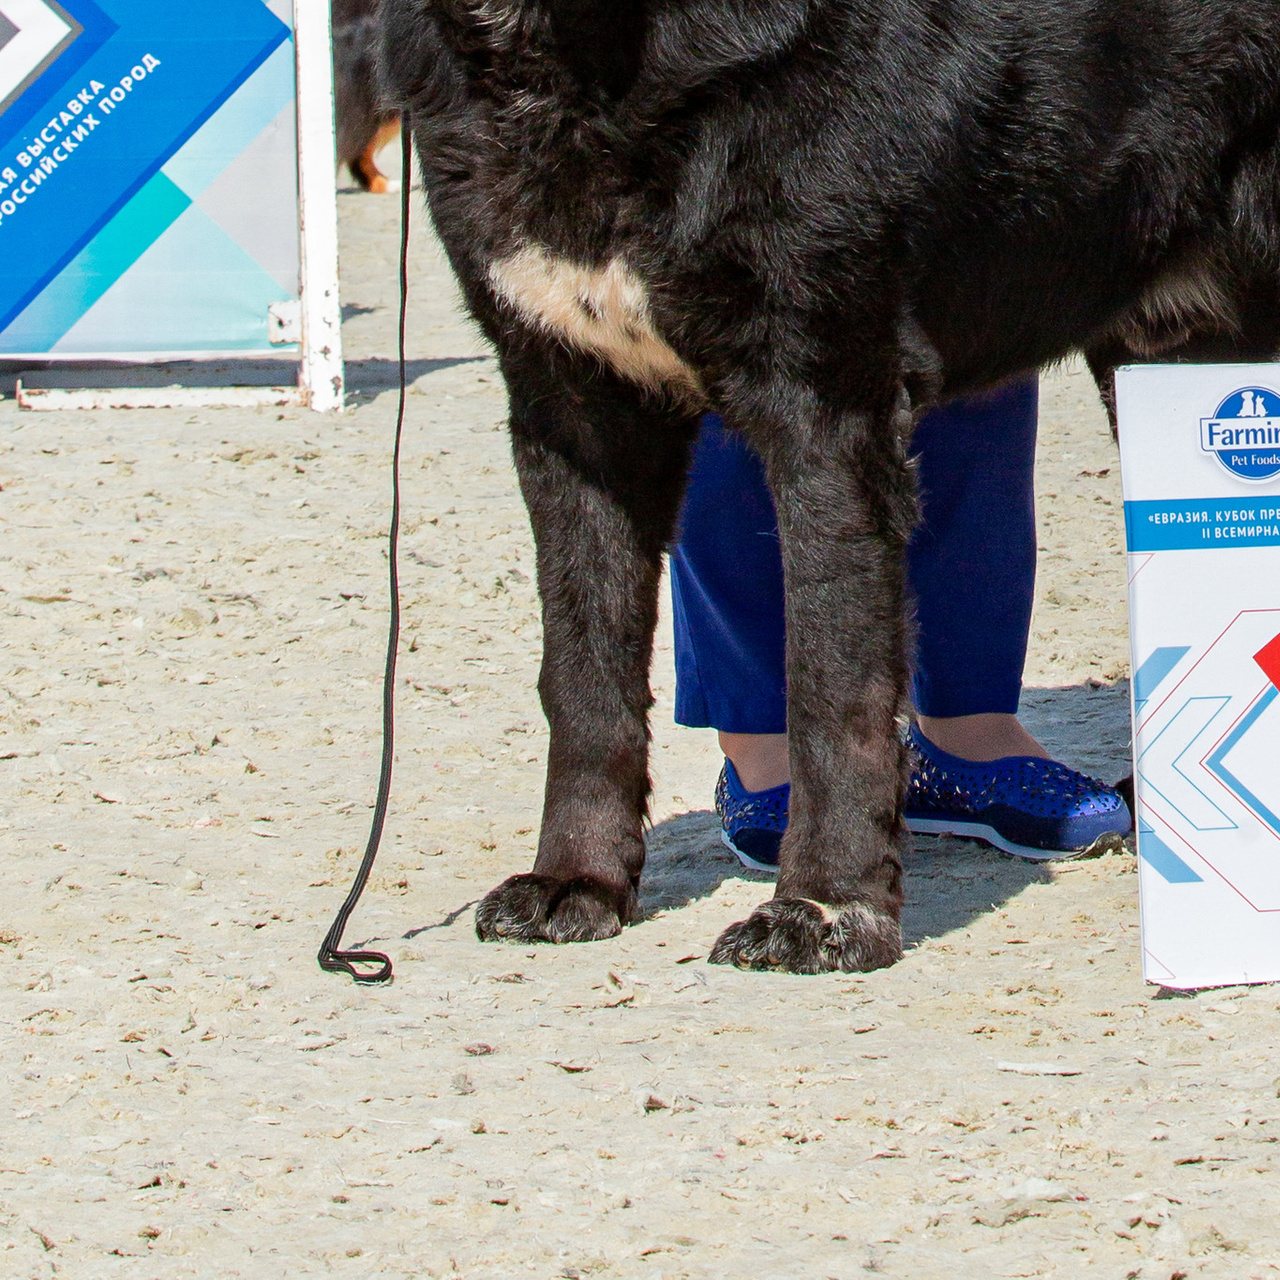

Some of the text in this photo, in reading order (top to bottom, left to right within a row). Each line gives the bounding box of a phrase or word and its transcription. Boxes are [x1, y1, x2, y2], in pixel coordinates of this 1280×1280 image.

[97, 53, 162, 115] ПОРОД
[15, 79, 106, 168] ВЫСТАВКА
[1231, 454, 1248, 466] Pet
[1148, 511, 1212, 524] «ЕВРАЗИЯ.
[1215, 509, 1255, 522] КУБОК
